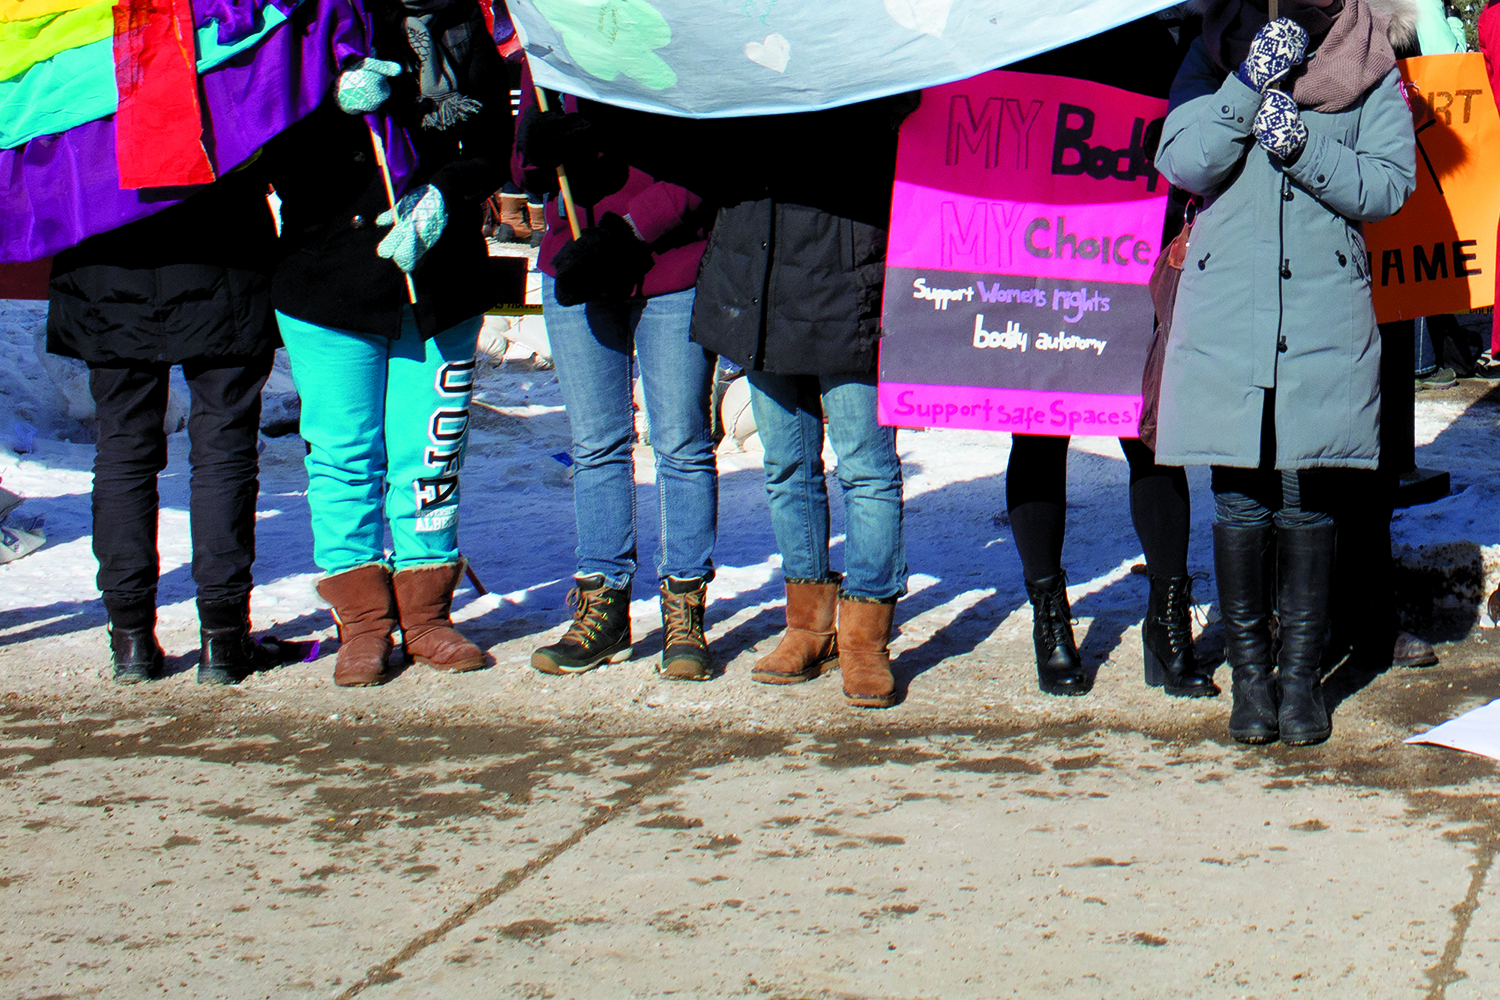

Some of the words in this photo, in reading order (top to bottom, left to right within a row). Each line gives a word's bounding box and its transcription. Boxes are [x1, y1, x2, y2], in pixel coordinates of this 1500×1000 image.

[944, 94, 1043, 171] MY
[940, 200, 1026, 268] MY
[1367, 239, 1483, 287] AME
[913, 278, 975, 310] Support
[976, 280, 1047, 307] Womens
[1052, 287, 1111, 323] rights
[1035, 331, 1107, 356] autonomy
[894, 390, 992, 424] Support
[997, 404, 1046, 431] safe
[1050, 399, 1141, 432] Spaces!
